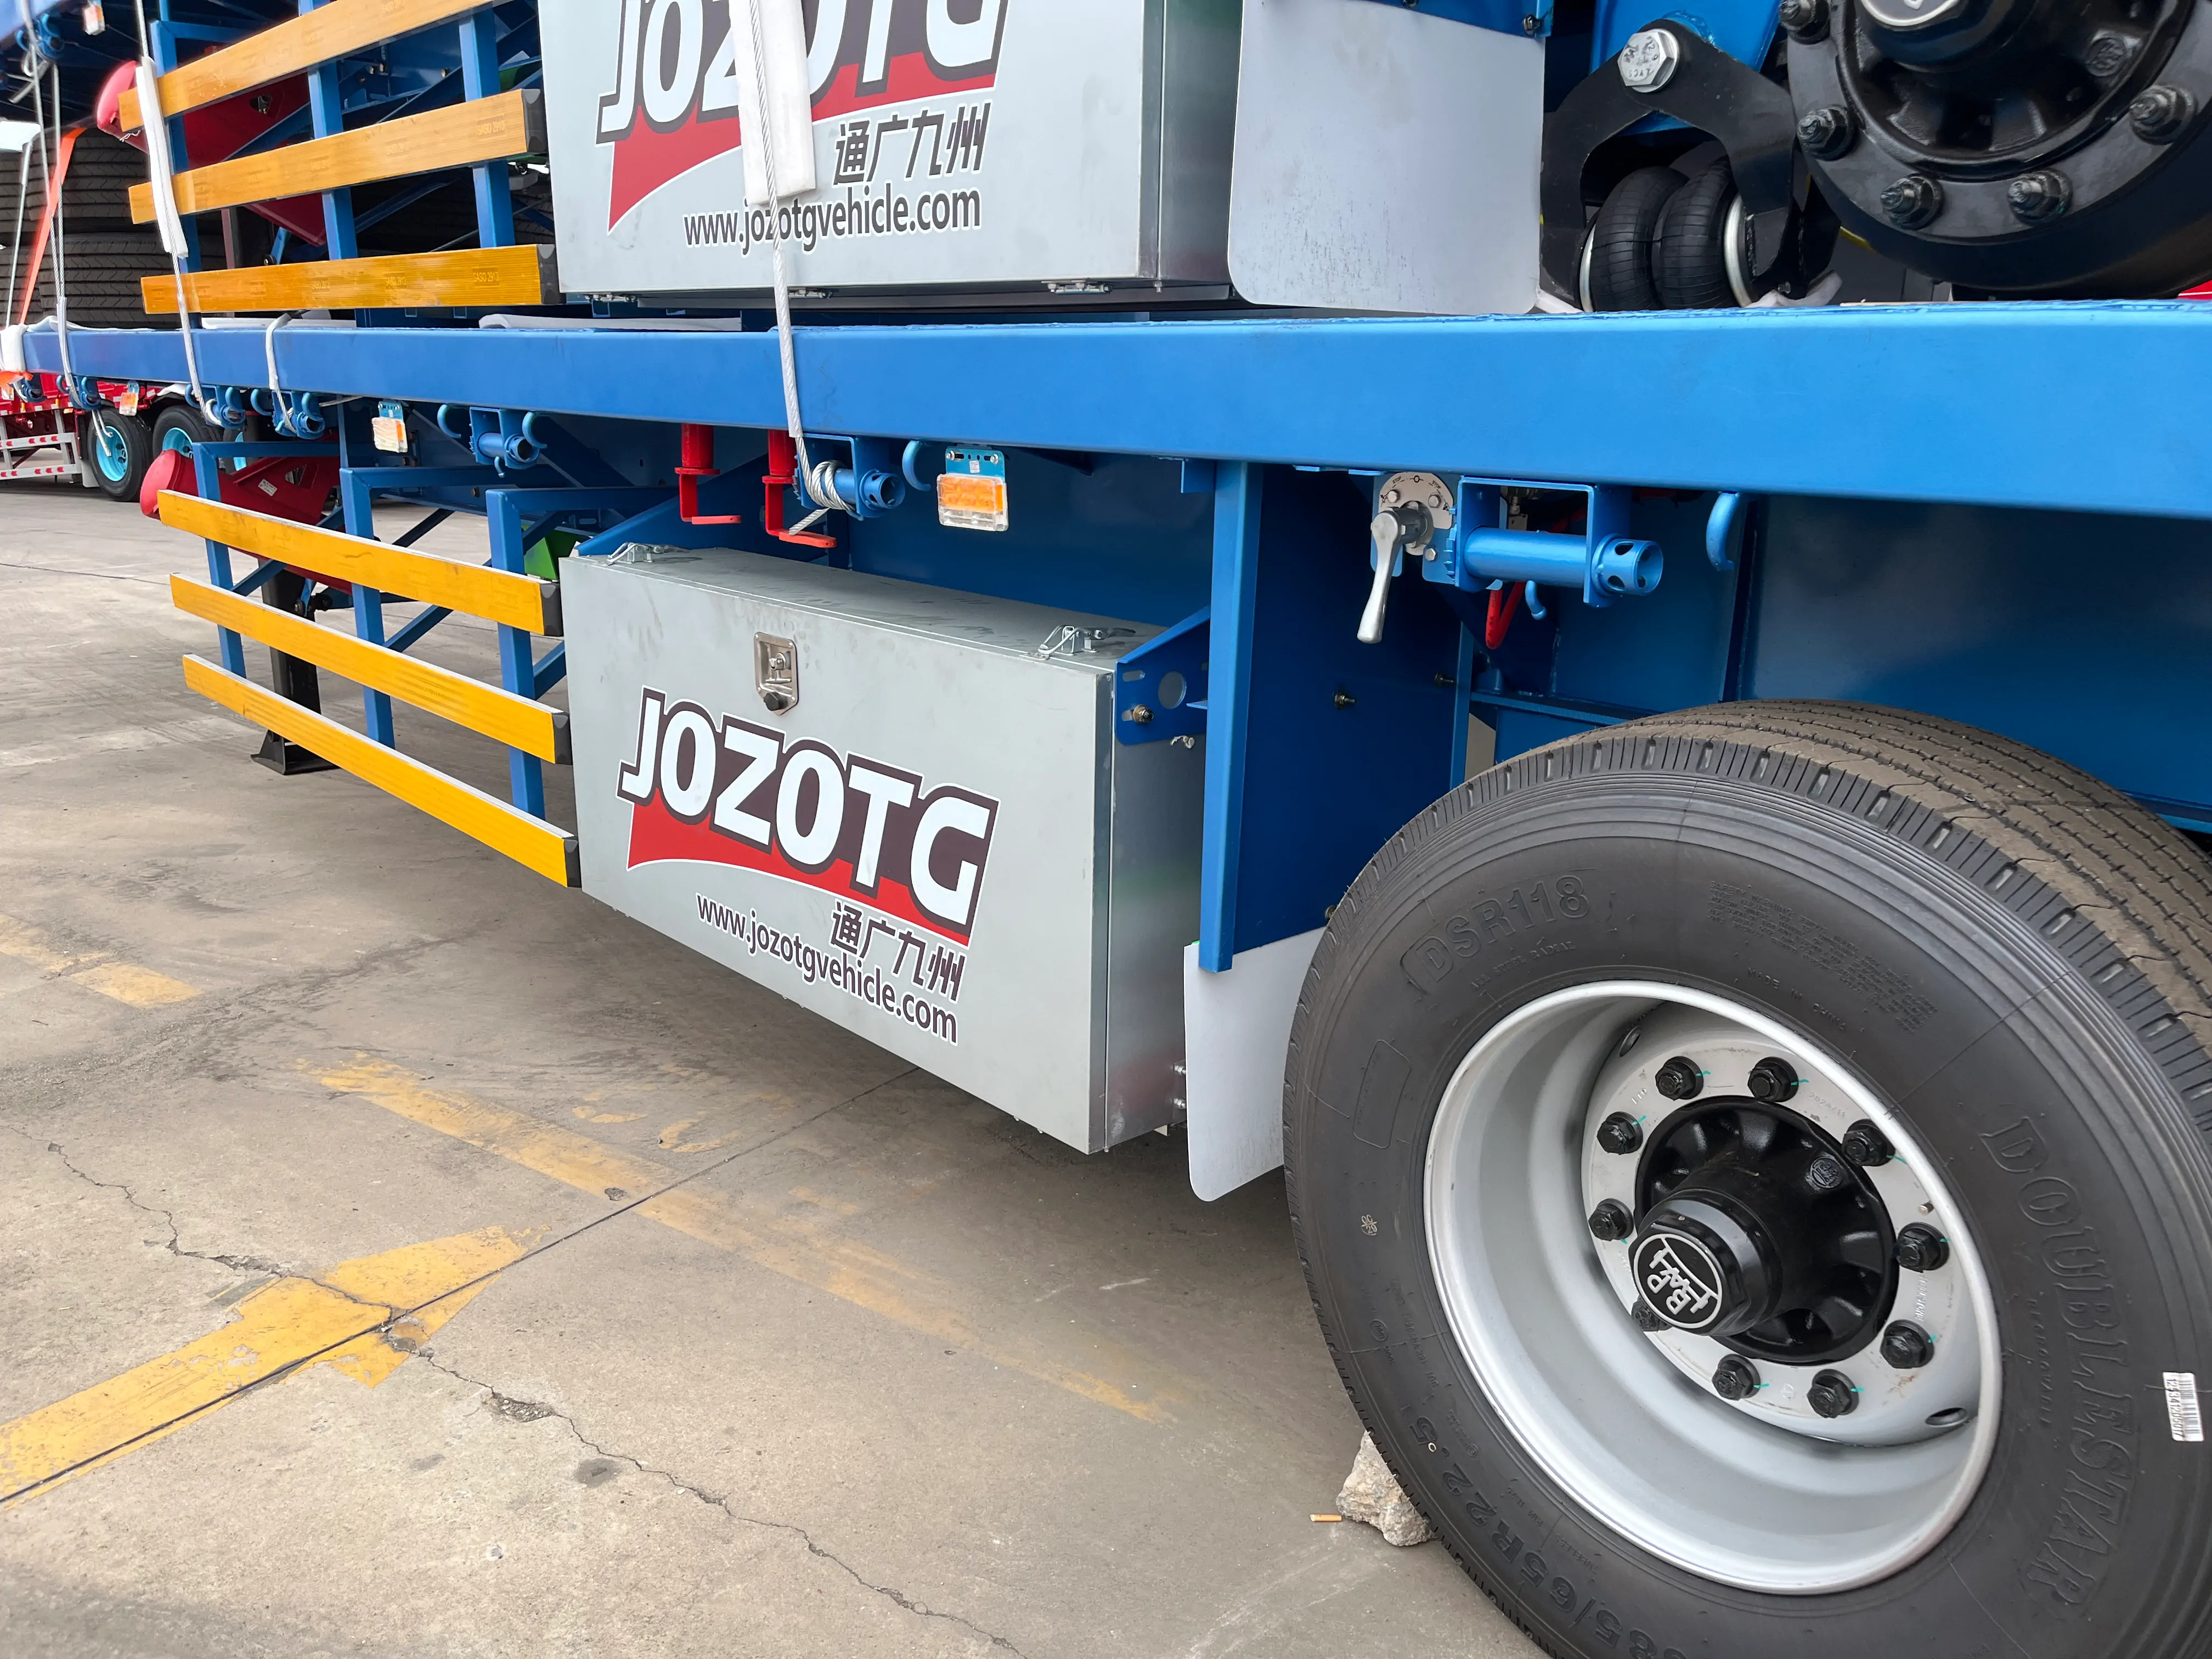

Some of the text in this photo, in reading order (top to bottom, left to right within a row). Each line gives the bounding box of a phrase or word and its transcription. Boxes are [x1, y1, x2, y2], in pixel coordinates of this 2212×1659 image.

[834, 102, 990, 184] 通广九州
[684, 183, 980, 255] www.jozotgvehicle.com
[1392, 476, 1402, 484] STOP
[1431, 480, 1441, 489] STOP
[618, 688, 998, 933] JOZOTG
[697, 894, 957, 1044] www.jozotgvehicle.com
[832, 901, 966, 1002] 通广九州
[1415, 874, 1590, 984] DSR118
[1746, 966, 1847, 1032] MADE IN CHINA
[1979, 1115, 2134, 1605] DOUBLESTAR
[1409, 1417, 1688, 1659] 85/65R22.5
